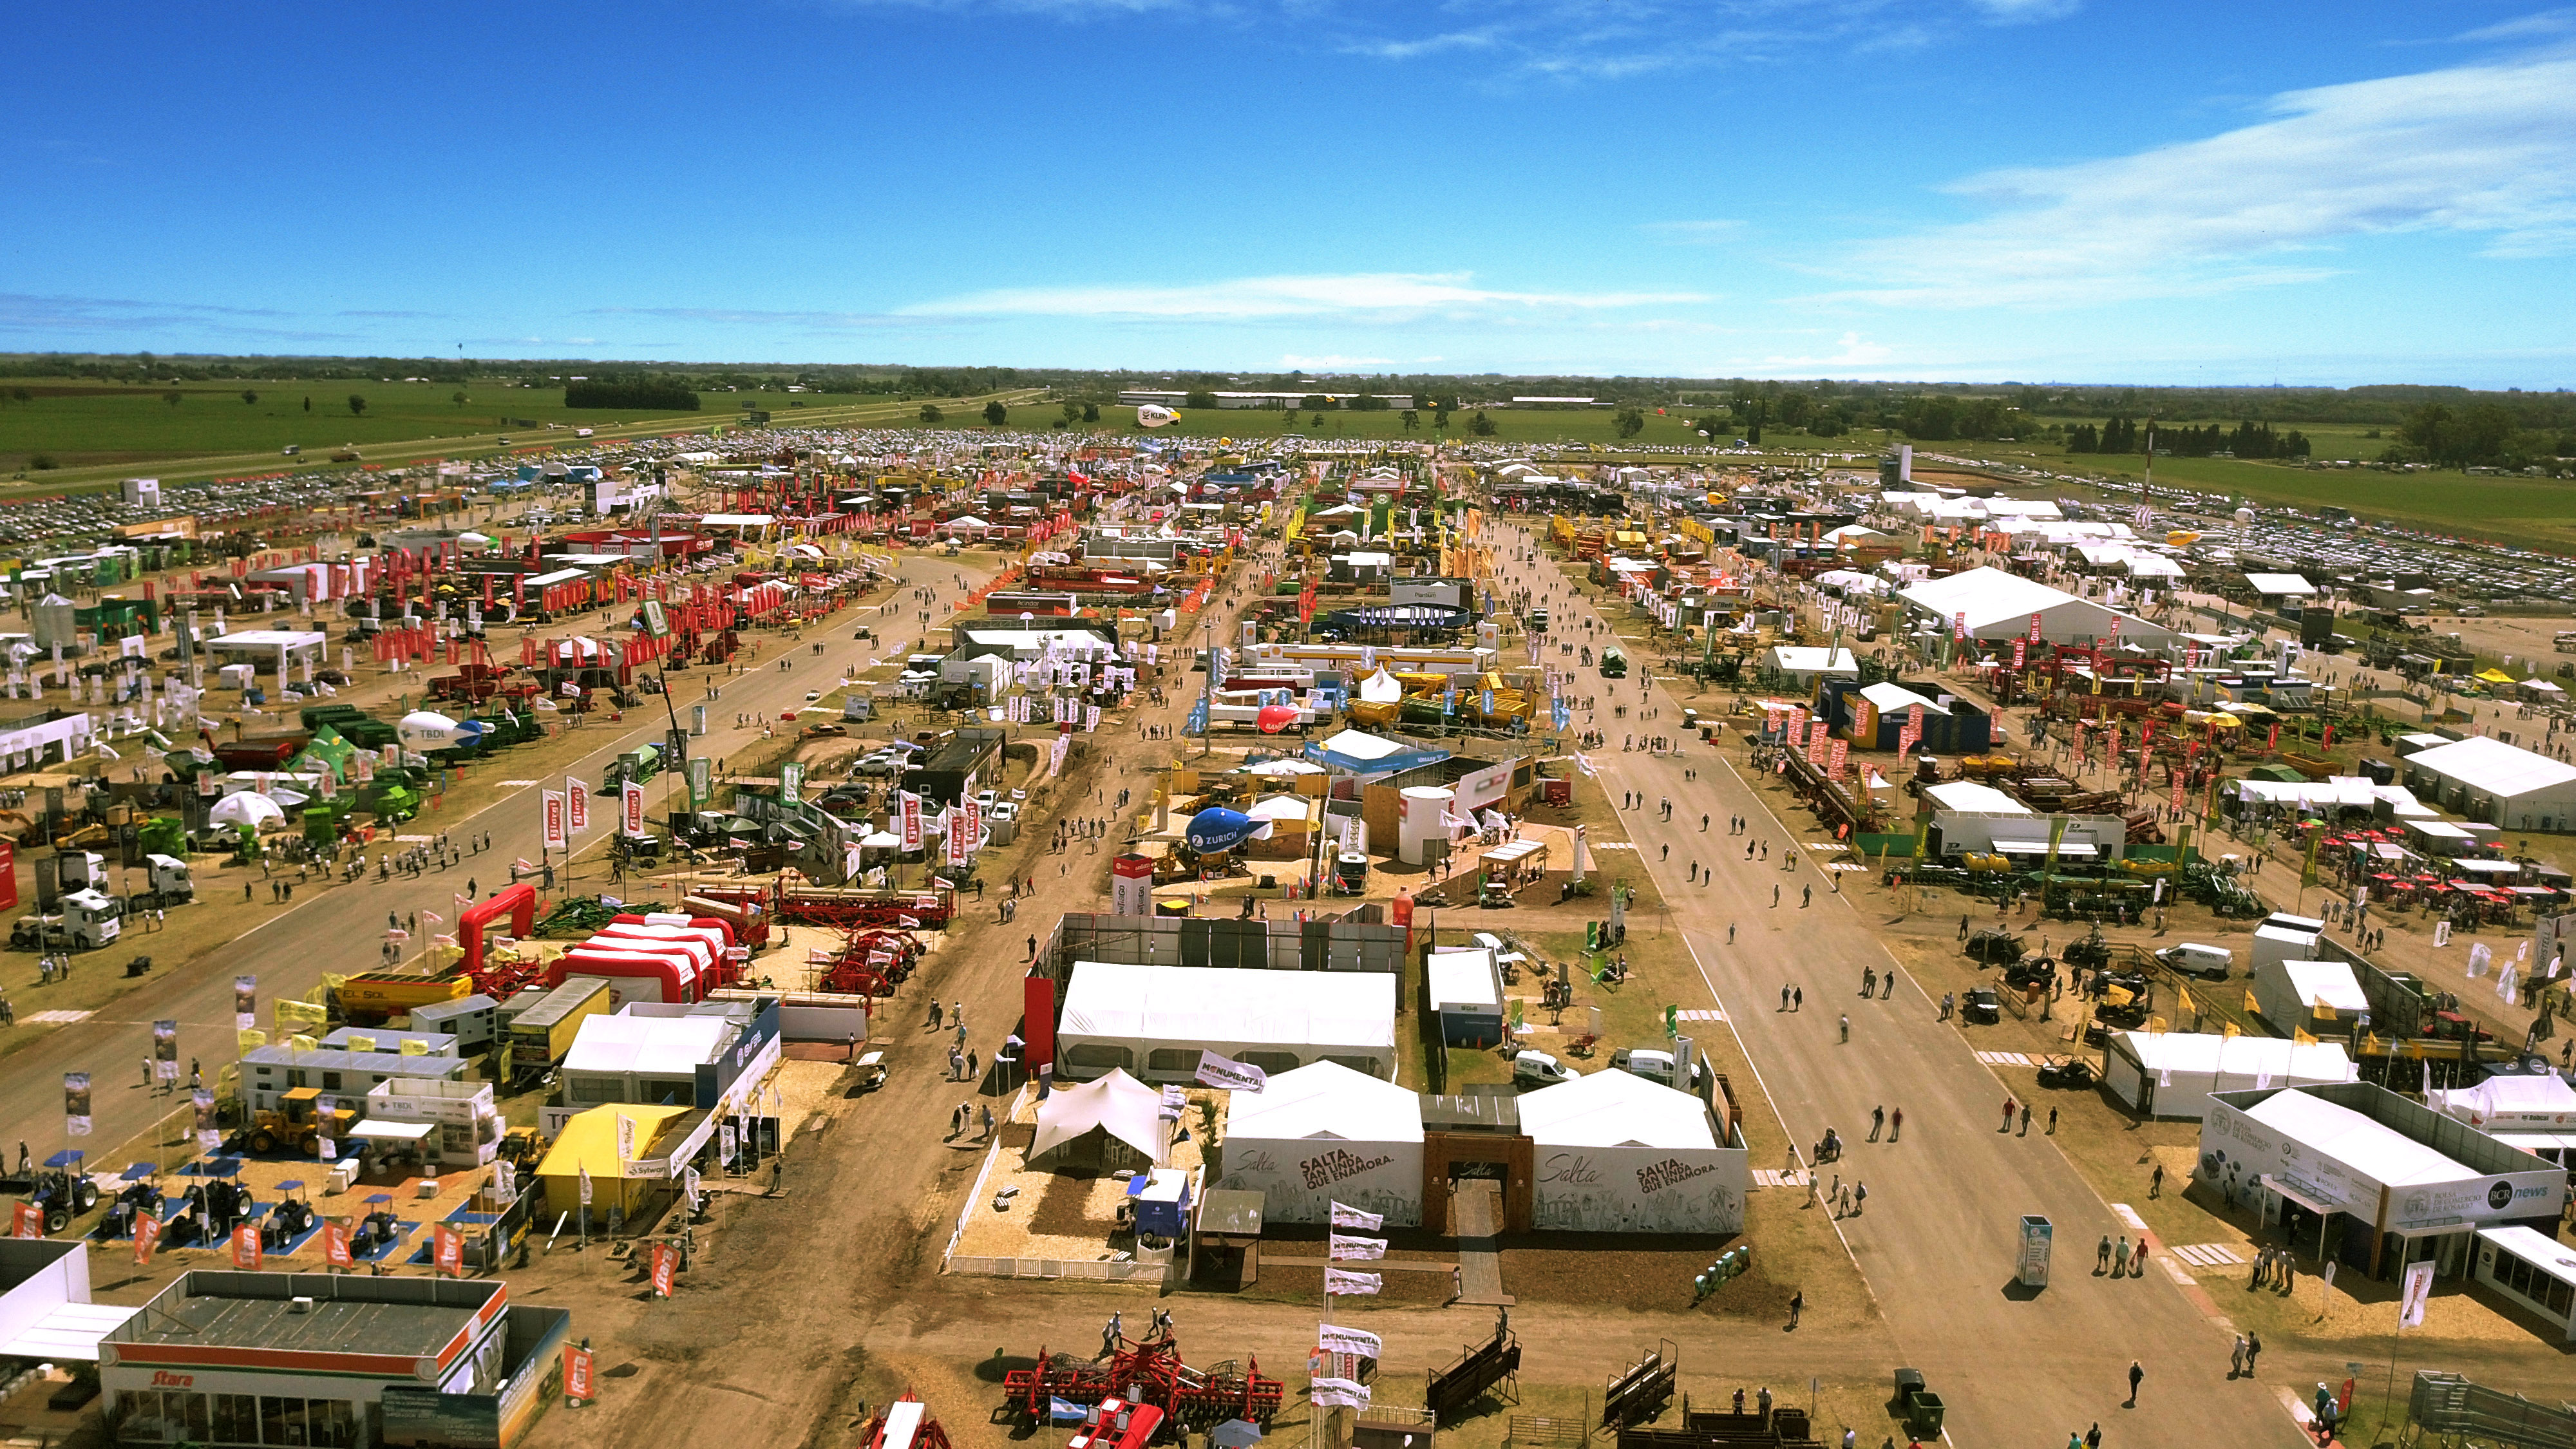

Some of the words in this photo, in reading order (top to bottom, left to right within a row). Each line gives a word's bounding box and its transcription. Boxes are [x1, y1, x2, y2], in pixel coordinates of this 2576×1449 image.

[2014, 642, 2025, 667] DOLBI
[421, 730, 446, 739] TBDL
[1206, 831, 1237, 845] ZURICH
[2539, 931, 2551, 967] BRISTELL
[363, 990, 388, 999] SOL
[1202, 1063, 1265, 1087] MONUMENTAL
[638, 1166, 666, 1175] Sylwan
[1235, 1150, 1278, 1171] Salta
[1300, 1148, 1354, 1174] SALTA.
[1302, 1168, 1327, 1182] TAN
[1329, 1155, 1364, 1174] LINDA
[1459, 1161, 1496, 1177] Salta
[1538, 1153, 1605, 1184] Salta
[1636, 1158, 1684, 1180] SALTA.
[1307, 1176, 1331, 1190] QUE
[1332, 1155, 1395, 1182] ENAMORA.
[1638, 1175, 1660, 1186] TAN
[1662, 1164, 1692, 1180] LINDA
[1642, 1181, 1663, 1193] QUE
[1664, 1163, 1719, 1186] ENAMORA.
[2445, 1195, 2481, 1204] COMERCIO
[2490, 1189, 2510, 1201] BCR
[2514, 1186, 2548, 1198] news
[2443, 1203, 2474, 1211] ROSARIO
[1334, 1242, 1383, 1251] MONUMENTAL
[656, 1249, 673, 1293] Stara
[1321, 1333, 1380, 1346] MONUMENTAL
[151, 1370, 194, 1387] Stara
[571, 1355, 588, 1394] Stara
[1311, 1386, 1369, 1399] MONUMENTAL
